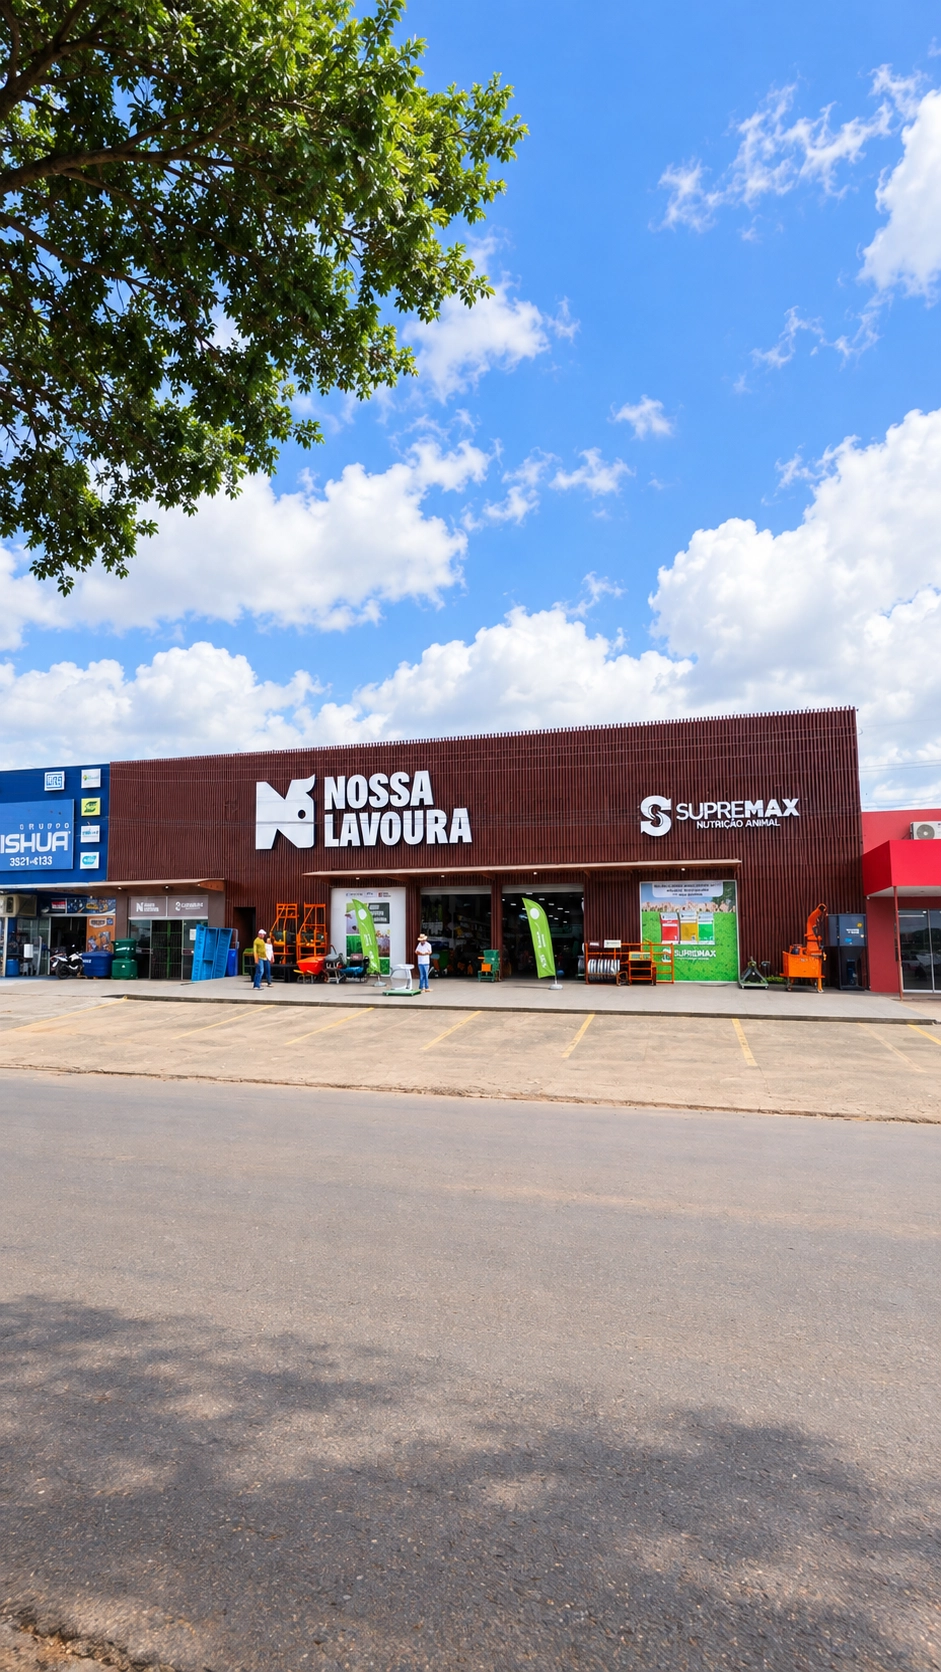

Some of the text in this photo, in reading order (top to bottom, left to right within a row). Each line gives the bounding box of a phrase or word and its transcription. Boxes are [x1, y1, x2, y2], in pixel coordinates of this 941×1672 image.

[324, 770, 434, 810] NOSSA
[676, 798, 800, 821] SUPREMAX
[696, 818, 781, 829] NUTRIÇÃO ANIMAL
[324, 807, 473, 848] LAVOURA
